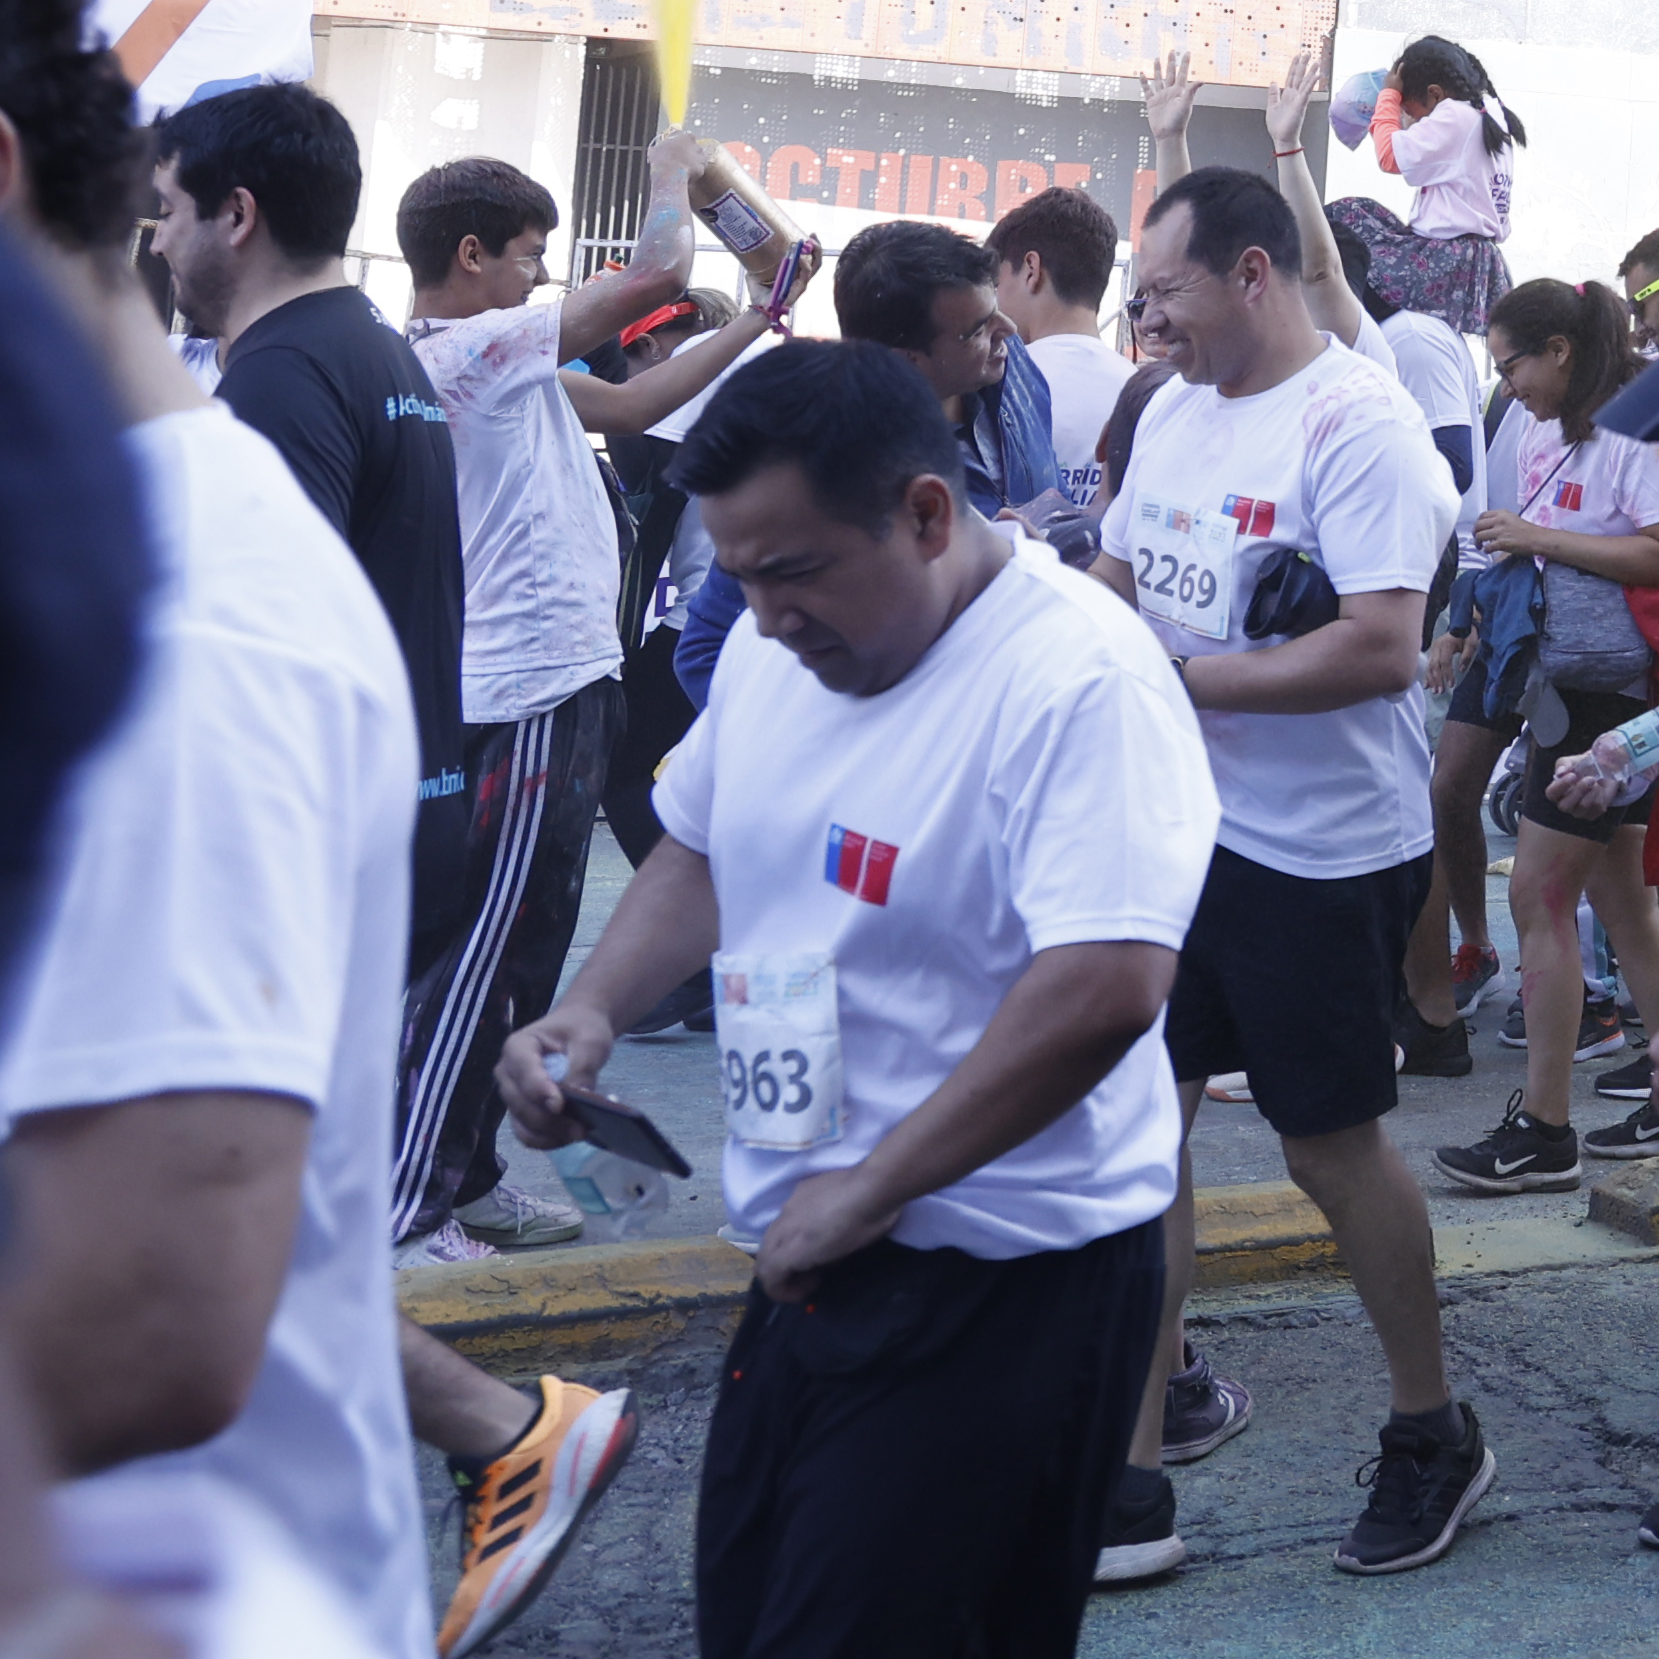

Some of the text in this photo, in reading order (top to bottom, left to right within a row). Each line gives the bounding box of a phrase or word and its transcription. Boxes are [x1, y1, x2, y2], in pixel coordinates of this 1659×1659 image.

[1060, 468, 1102, 487] RRID
[1137, 546, 1218, 610] 2269
[724, 1048, 814, 1114] 963
